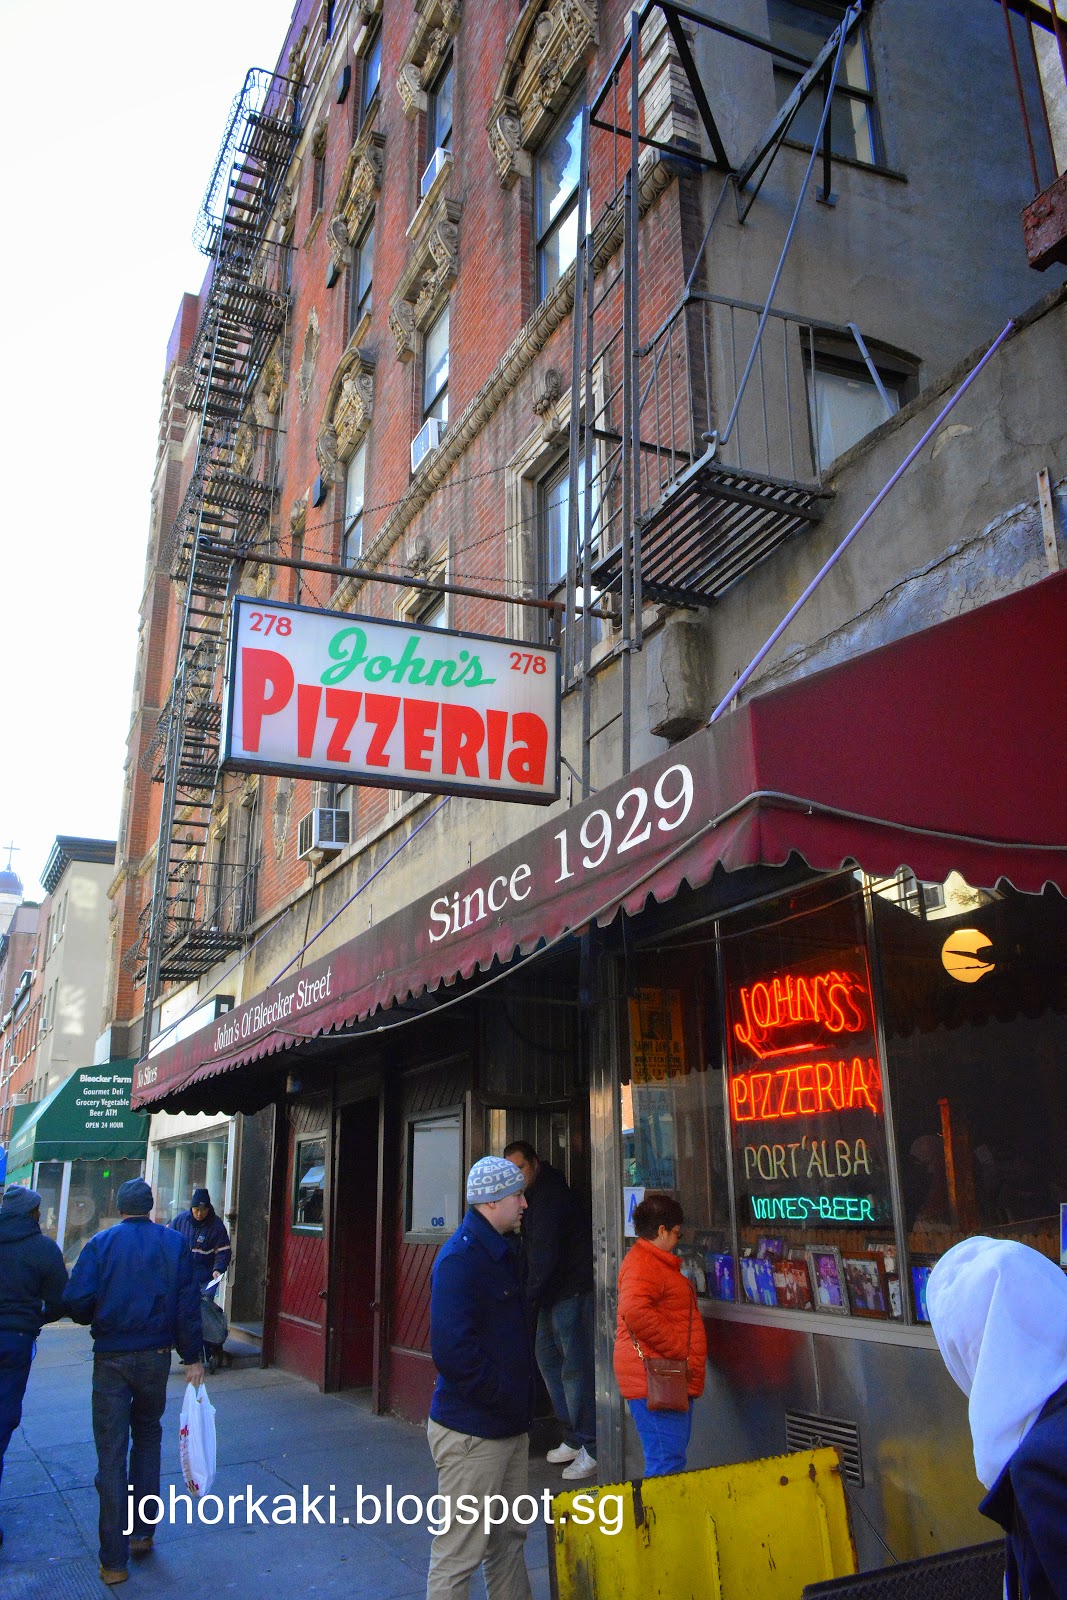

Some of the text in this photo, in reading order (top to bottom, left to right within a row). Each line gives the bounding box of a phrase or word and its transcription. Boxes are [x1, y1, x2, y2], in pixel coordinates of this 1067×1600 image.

[250, 612, 292, 637] 278
[320, 627, 497, 688] John's
[509, 651, 547, 675] 278
[428, 763, 694, 943] Since 1929
[214, 966, 332, 1052] John's Of Bleecker Street
[734, 974, 851, 1044] JOHN'S
[79, 1074, 132, 1084] Bleecker Farm
[83, 1087, 124, 1095] Gourmet Deli
[733, 1057, 877, 1122] PIZZERIA
[76, 1098, 130, 1107] Grocery Vegetable
[89, 1109, 118, 1117] Beer ATM
